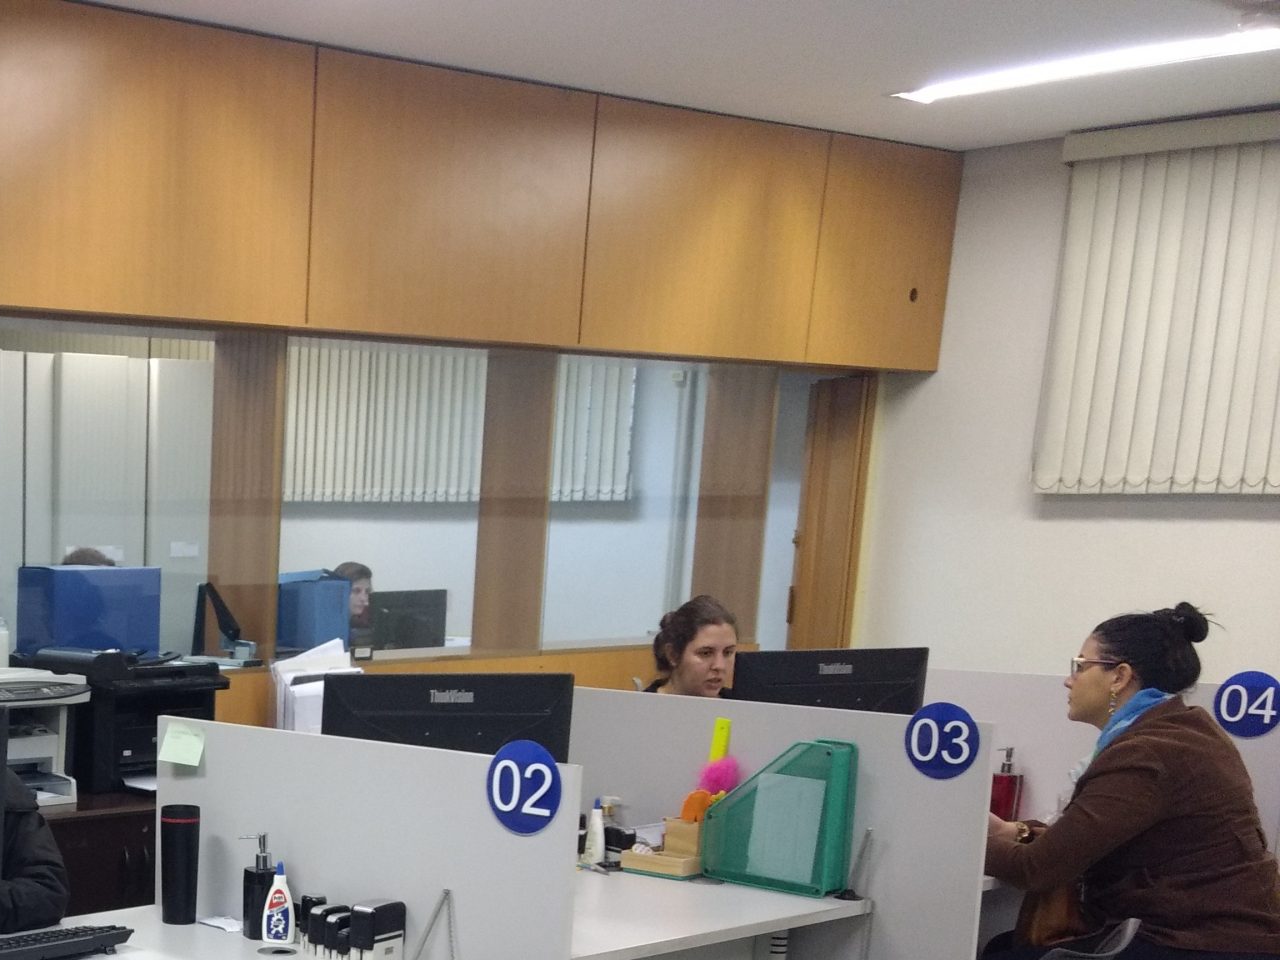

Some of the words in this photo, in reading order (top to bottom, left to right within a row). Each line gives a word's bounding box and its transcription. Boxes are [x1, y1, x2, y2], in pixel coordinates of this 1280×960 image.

[1220, 684, 1277, 724] 04
[911, 718, 970, 764] 03
[492, 759, 552, 817] 02
